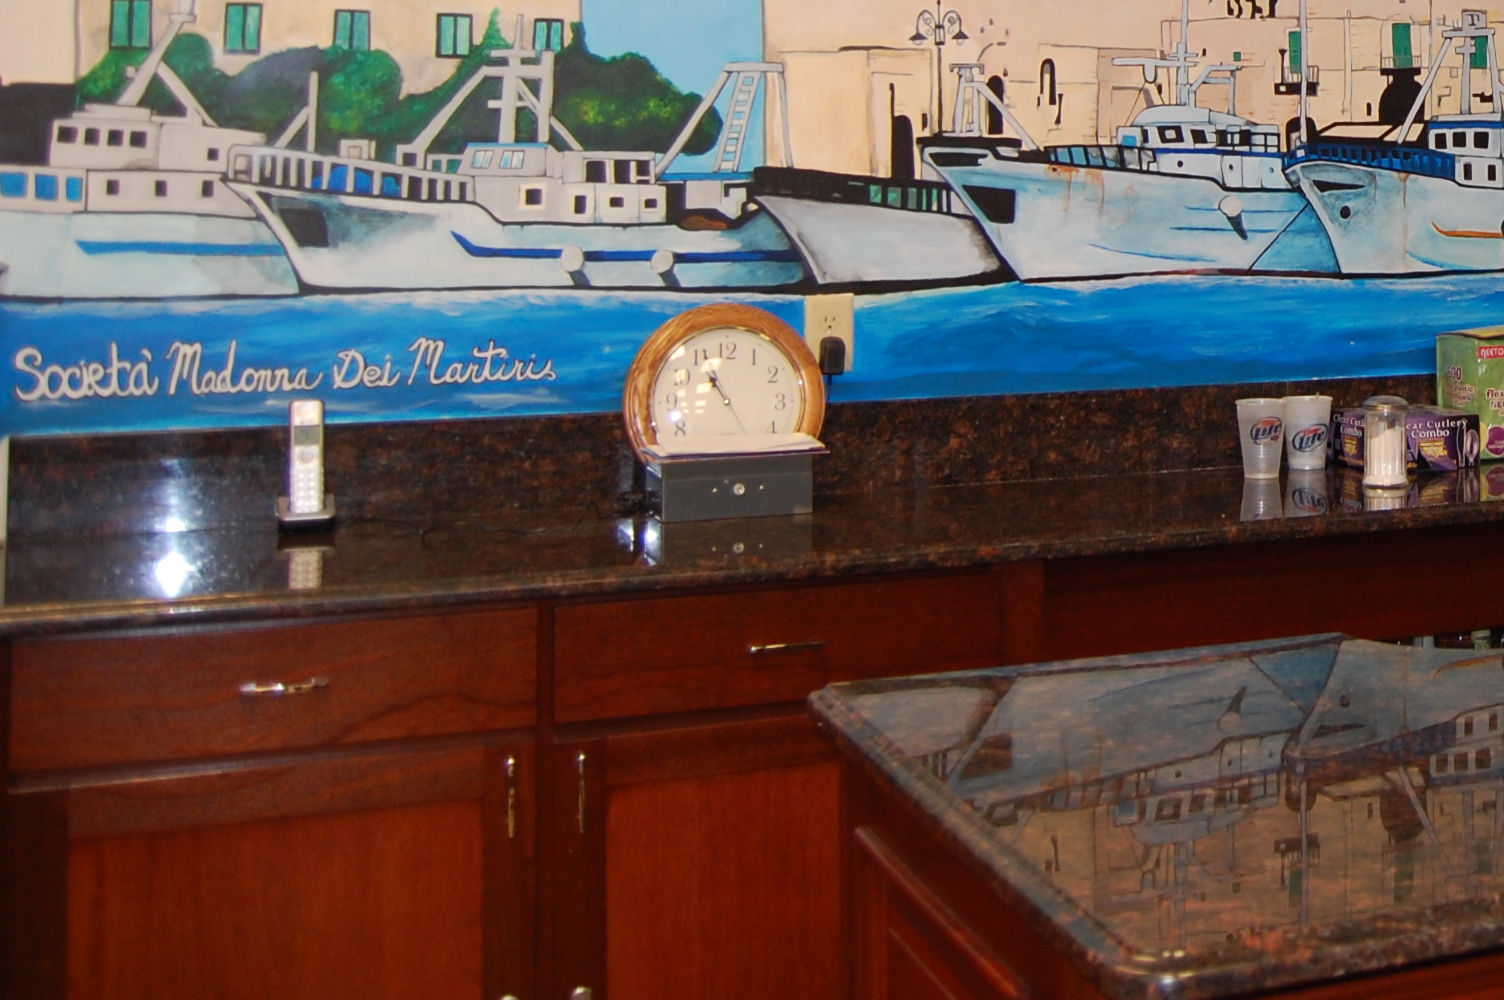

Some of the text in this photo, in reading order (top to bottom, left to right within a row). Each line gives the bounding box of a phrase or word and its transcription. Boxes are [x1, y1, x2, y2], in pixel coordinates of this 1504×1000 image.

[719, 342, 737, 360] 12
[751, 348, 757, 366] 1
[15, 336, 557, 401] Società Madonna Dei Martiris
[767, 366, 779, 384] 2
[666, 393, 786, 411] 9 3
[674, 420, 778, 437] 8 4
[1426, 418, 1468, 430] Cutlery
[1411, 429, 1450, 439] Combo
